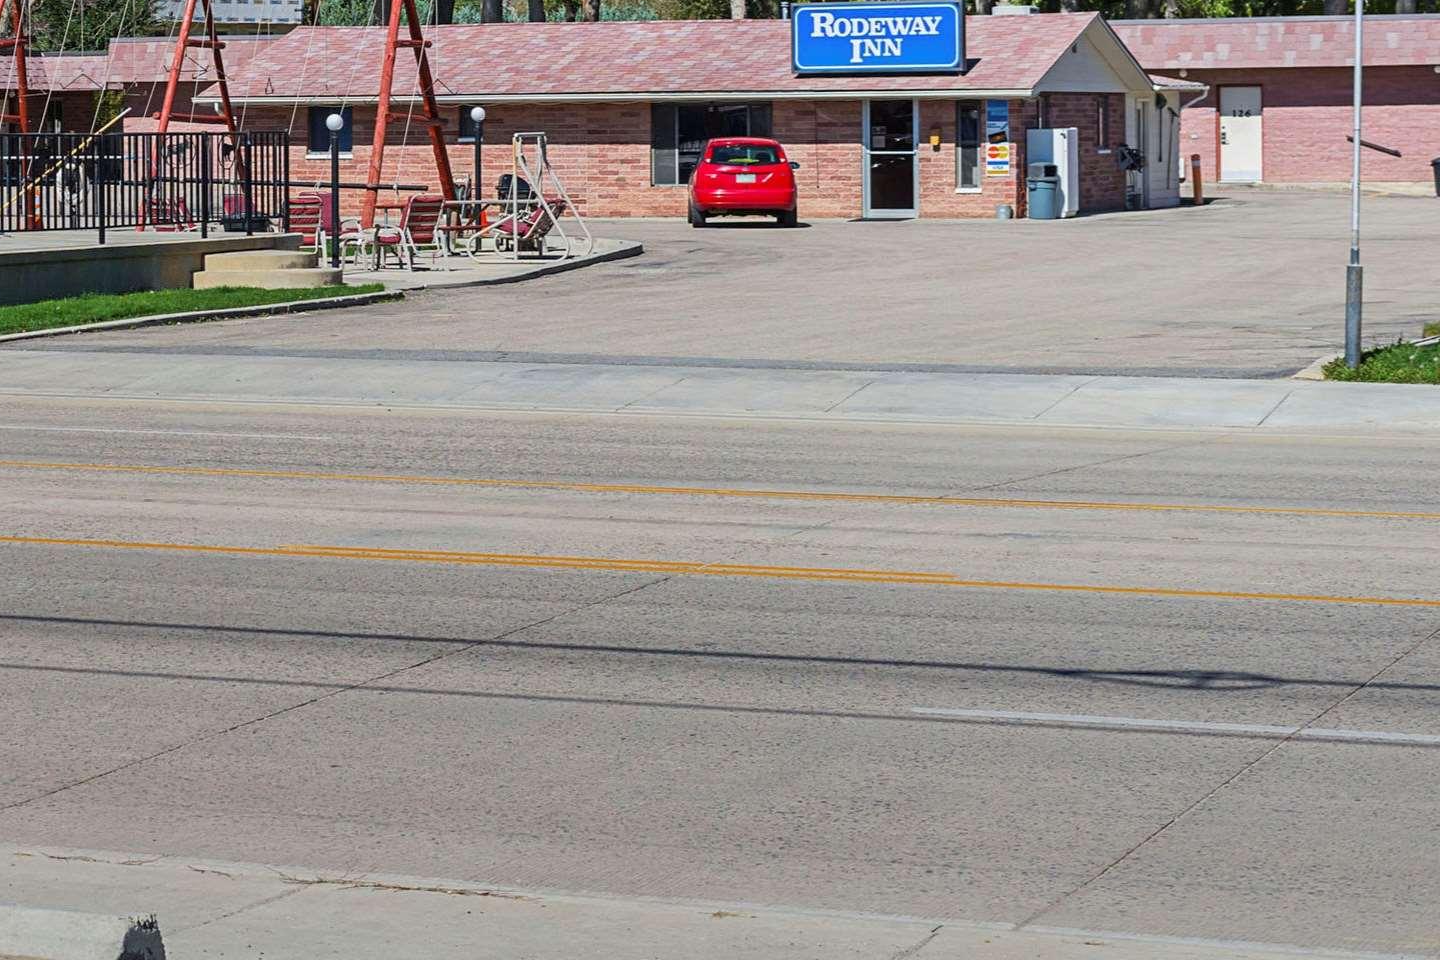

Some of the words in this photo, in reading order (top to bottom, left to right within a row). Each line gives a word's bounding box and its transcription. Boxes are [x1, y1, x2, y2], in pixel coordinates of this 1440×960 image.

[810, 12, 943, 38] RODEWAY
[849, 38, 903, 63] INN
[1232, 109, 1252, 118] 126
